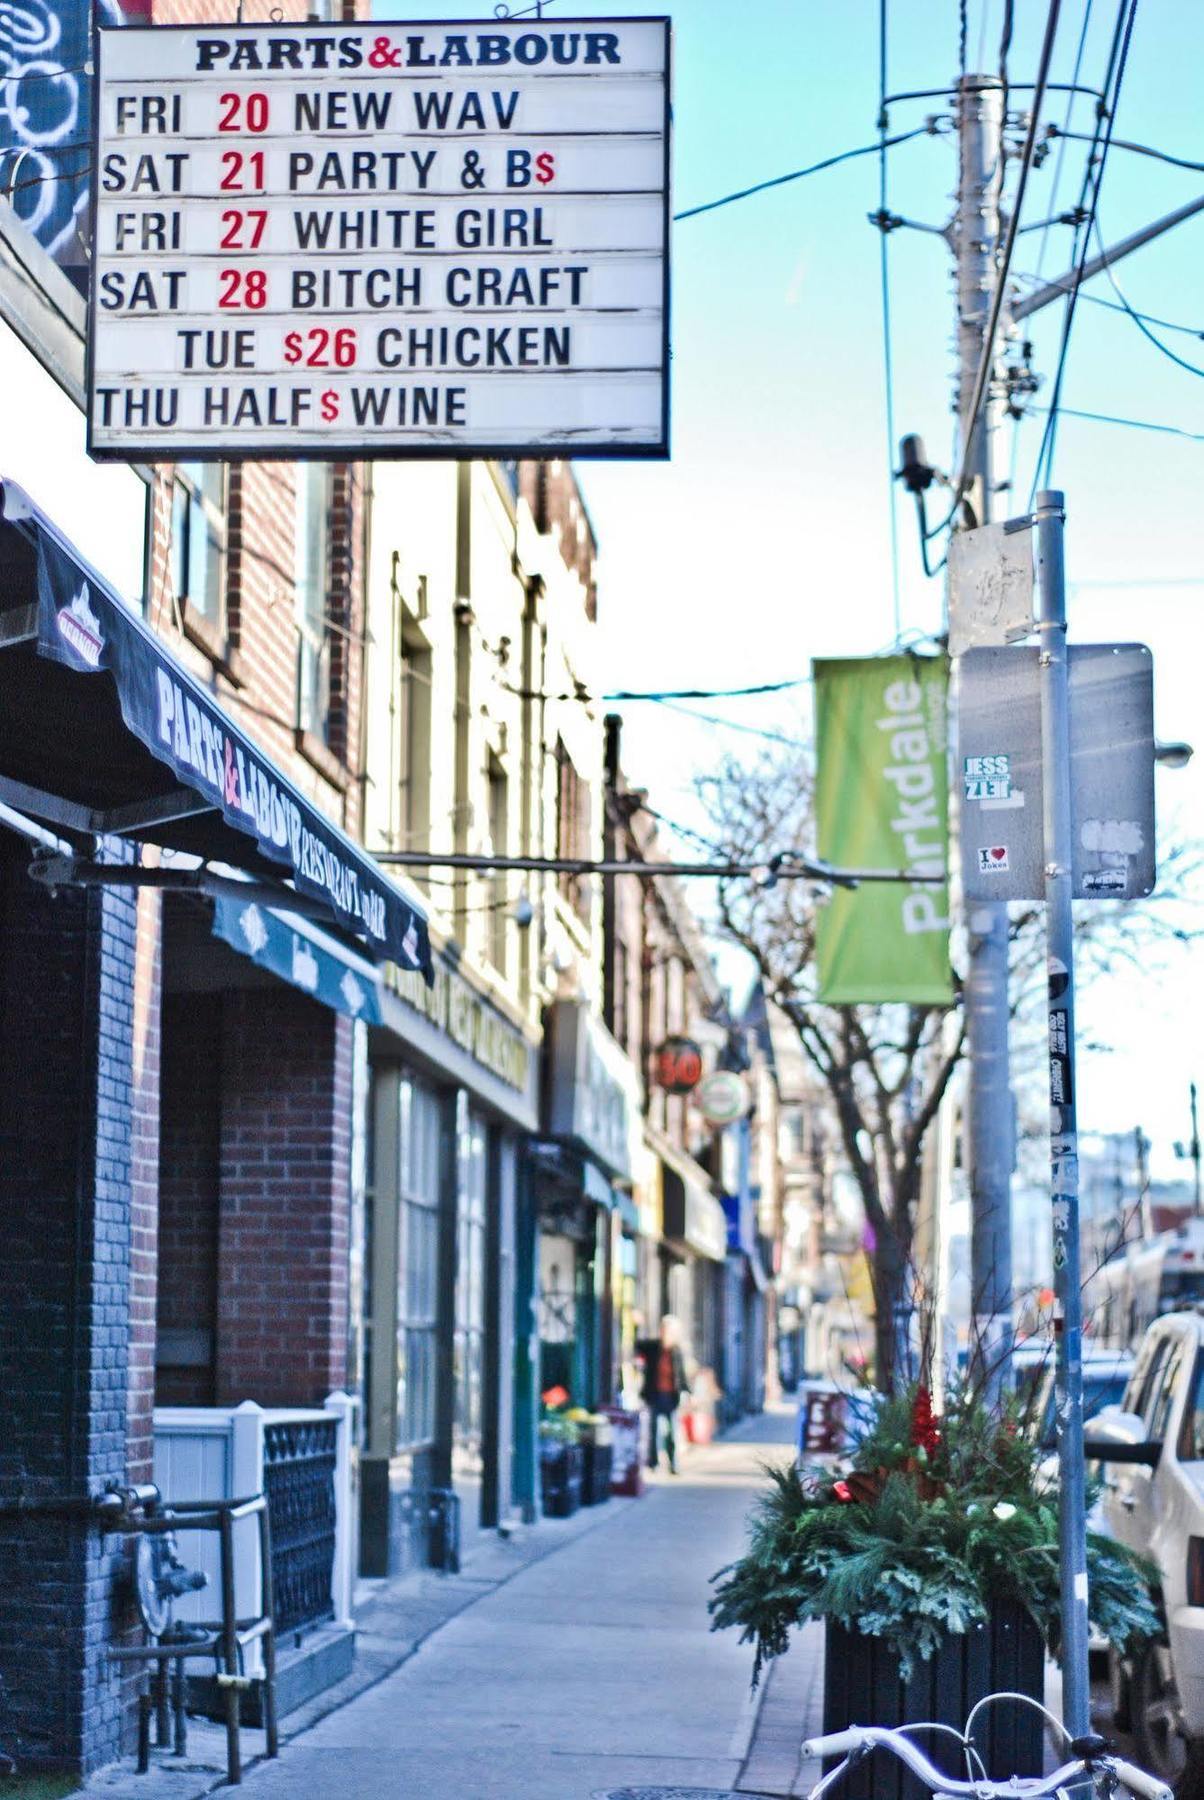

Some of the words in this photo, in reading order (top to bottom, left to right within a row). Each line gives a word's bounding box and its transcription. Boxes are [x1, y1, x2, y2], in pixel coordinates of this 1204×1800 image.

[118, 95, 180, 133] FRI
[219, 93, 268, 132] 20
[296, 92, 392, 130] NEW
[414, 91, 519, 129] WAV
[103, 154, 189, 191] SAT
[221, 152, 263, 190] 21
[290, 151, 436, 190] PARTY
[461, 150, 484, 189] &
[116, 212, 180, 250] FRI
[221, 210, 267, 248] 27
[295, 210, 435, 248] WHITE
[456, 208, 552, 248] GIRL
[101, 272, 186, 310] SAT
[219, 270, 266, 309] 28
[292, 268, 420, 308] BITCH
[447, 267, 588, 307] CRAFT
[178, 331, 254, 368] TUE
[285, 329, 356, 367] $26
[378, 327, 569, 367] CHICKEN
[96, 389, 178, 426] THU
[966, 756, 1009, 775] JESS
[876, 680, 949, 935] Parkdale
[980, 849, 989, 863] I
